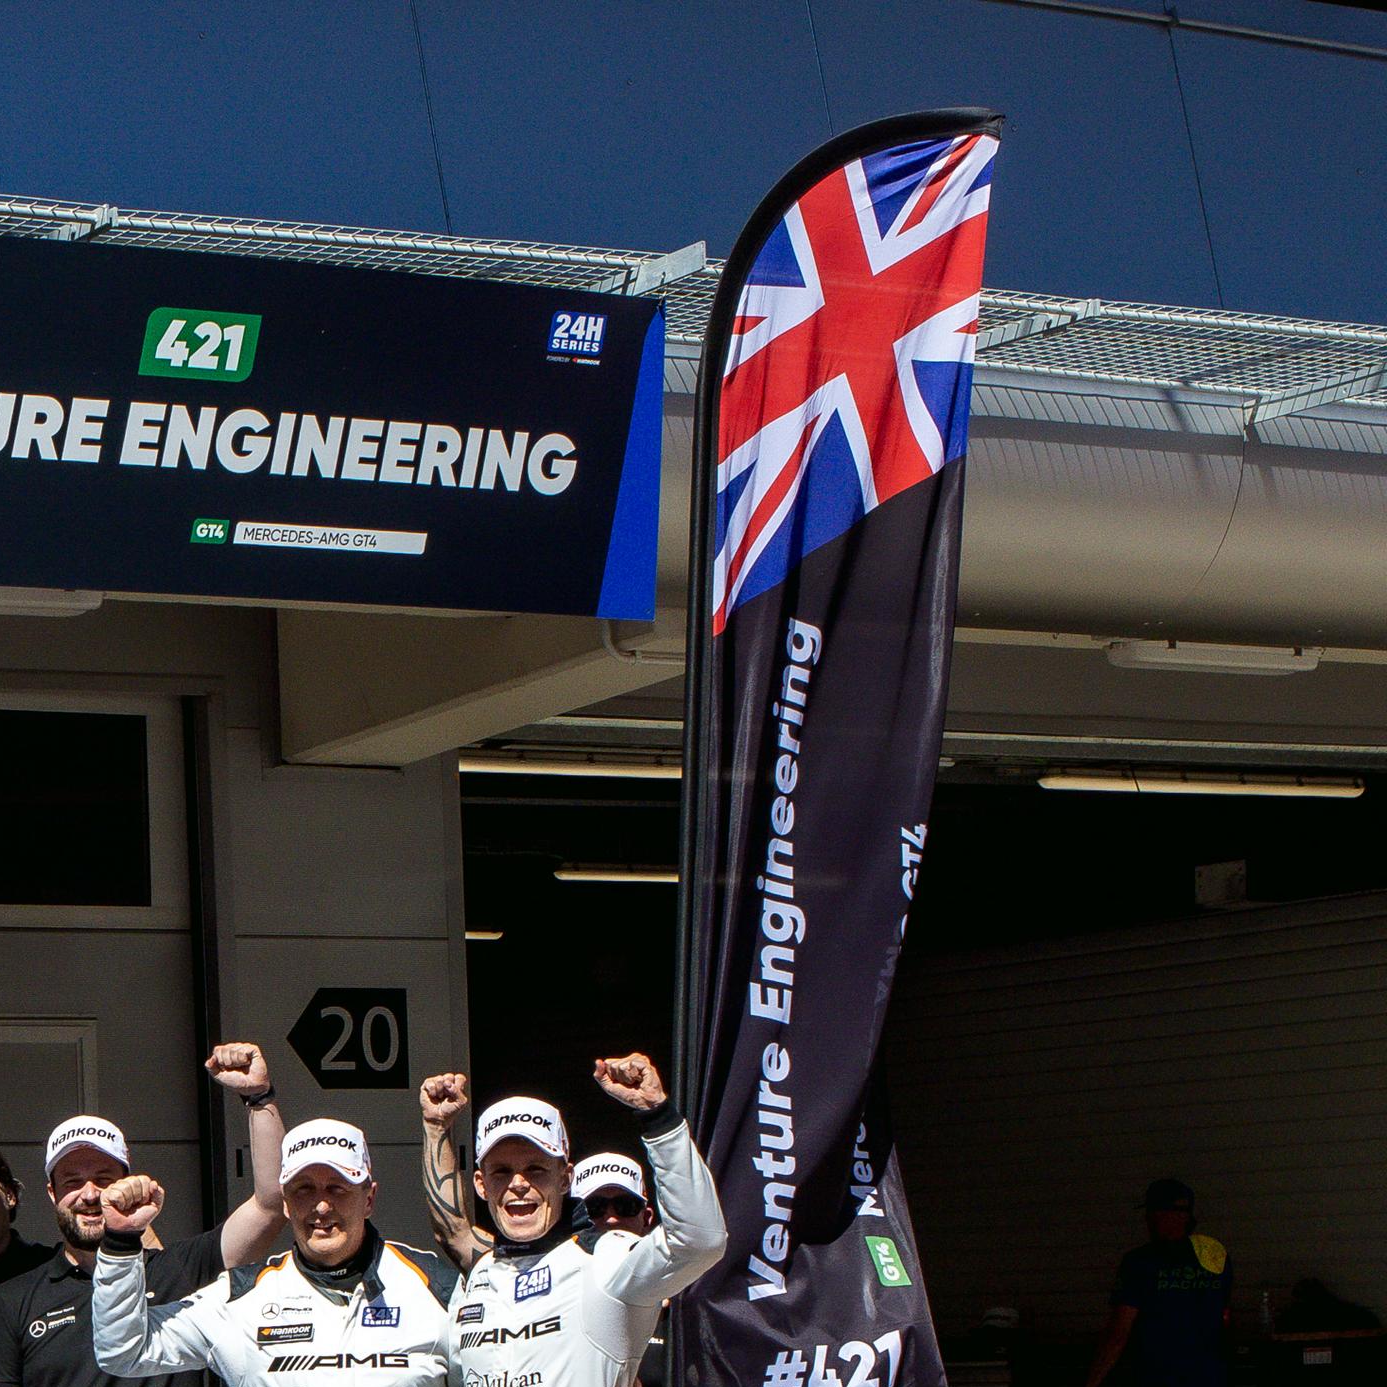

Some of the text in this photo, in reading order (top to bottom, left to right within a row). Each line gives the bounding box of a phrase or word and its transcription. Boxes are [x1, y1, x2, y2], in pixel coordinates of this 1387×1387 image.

[553, 312, 604, 342] 24H
[154, 319, 248, 373] 421
[551, 338, 600, 353] SERIES
[119, 401, 578, 495] ENGINEERING
[195, 522, 225, 539] GT4
[243, 527, 378, 549] MERCEDES-AMG GT4
[748, 616, 823, 1302] Venture Engineering
[319, 1005, 400, 1072] 20
[875, 1241, 901, 1282] GT4
[516, 1265, 550, 1292] 24H
[516, 1282, 550, 1299] SERIES
[476, 1315, 562, 1348] AMG
[308, 1352, 410, 1371] AMG
